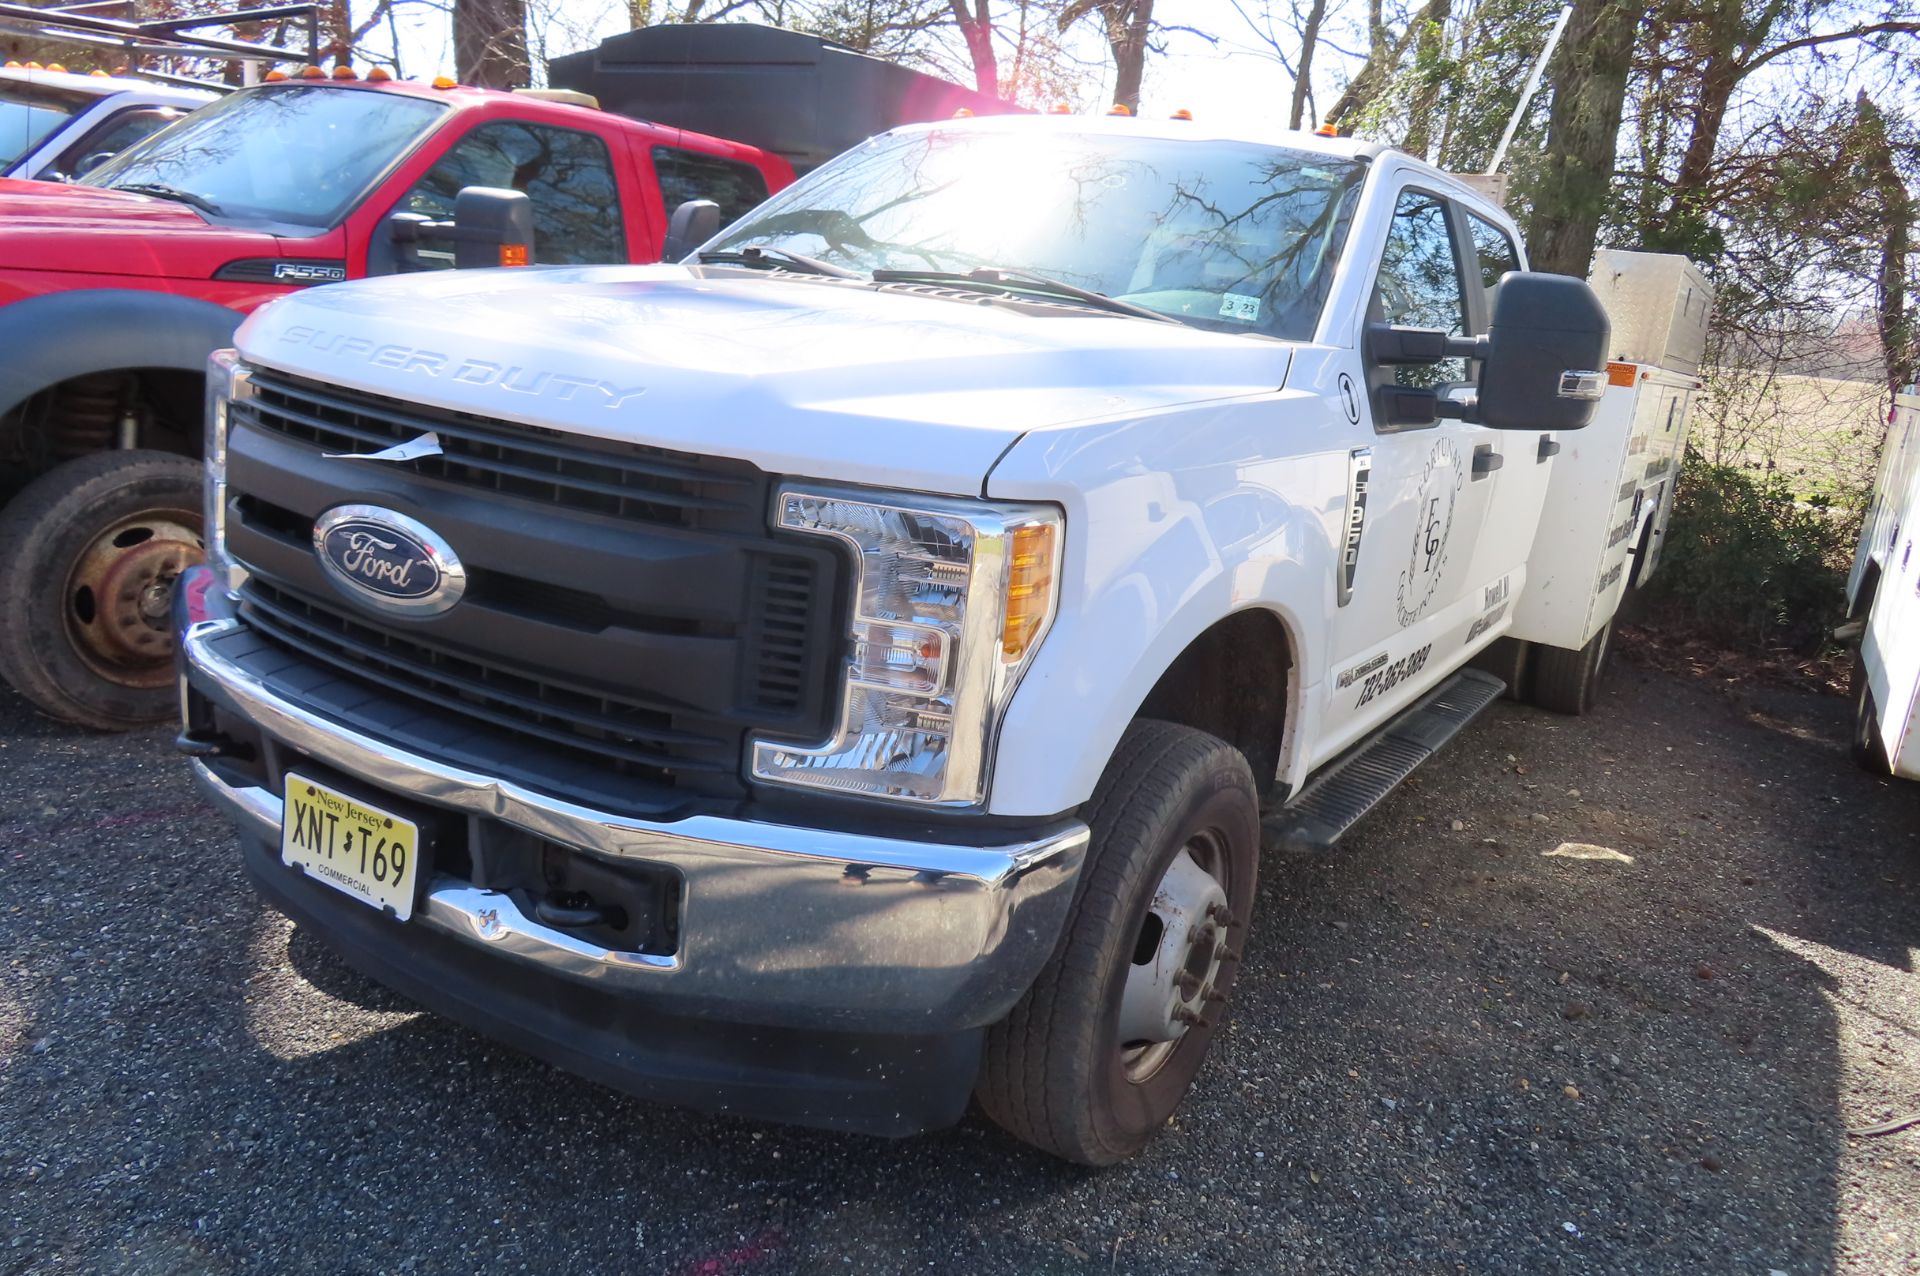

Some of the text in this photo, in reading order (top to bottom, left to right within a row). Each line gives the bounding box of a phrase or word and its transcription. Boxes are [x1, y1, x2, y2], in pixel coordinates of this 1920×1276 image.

[274, 263, 345, 281] F550
[279, 325, 648, 409] SUPER DUTY
[1417, 436, 1464, 497] FORTUNATO
[340, 530, 424, 589] Ford
[316, 788, 384, 832] New Jersey
[292, 799, 406, 888] XNT T69
[318, 863, 372, 896] COMMERCIAL
